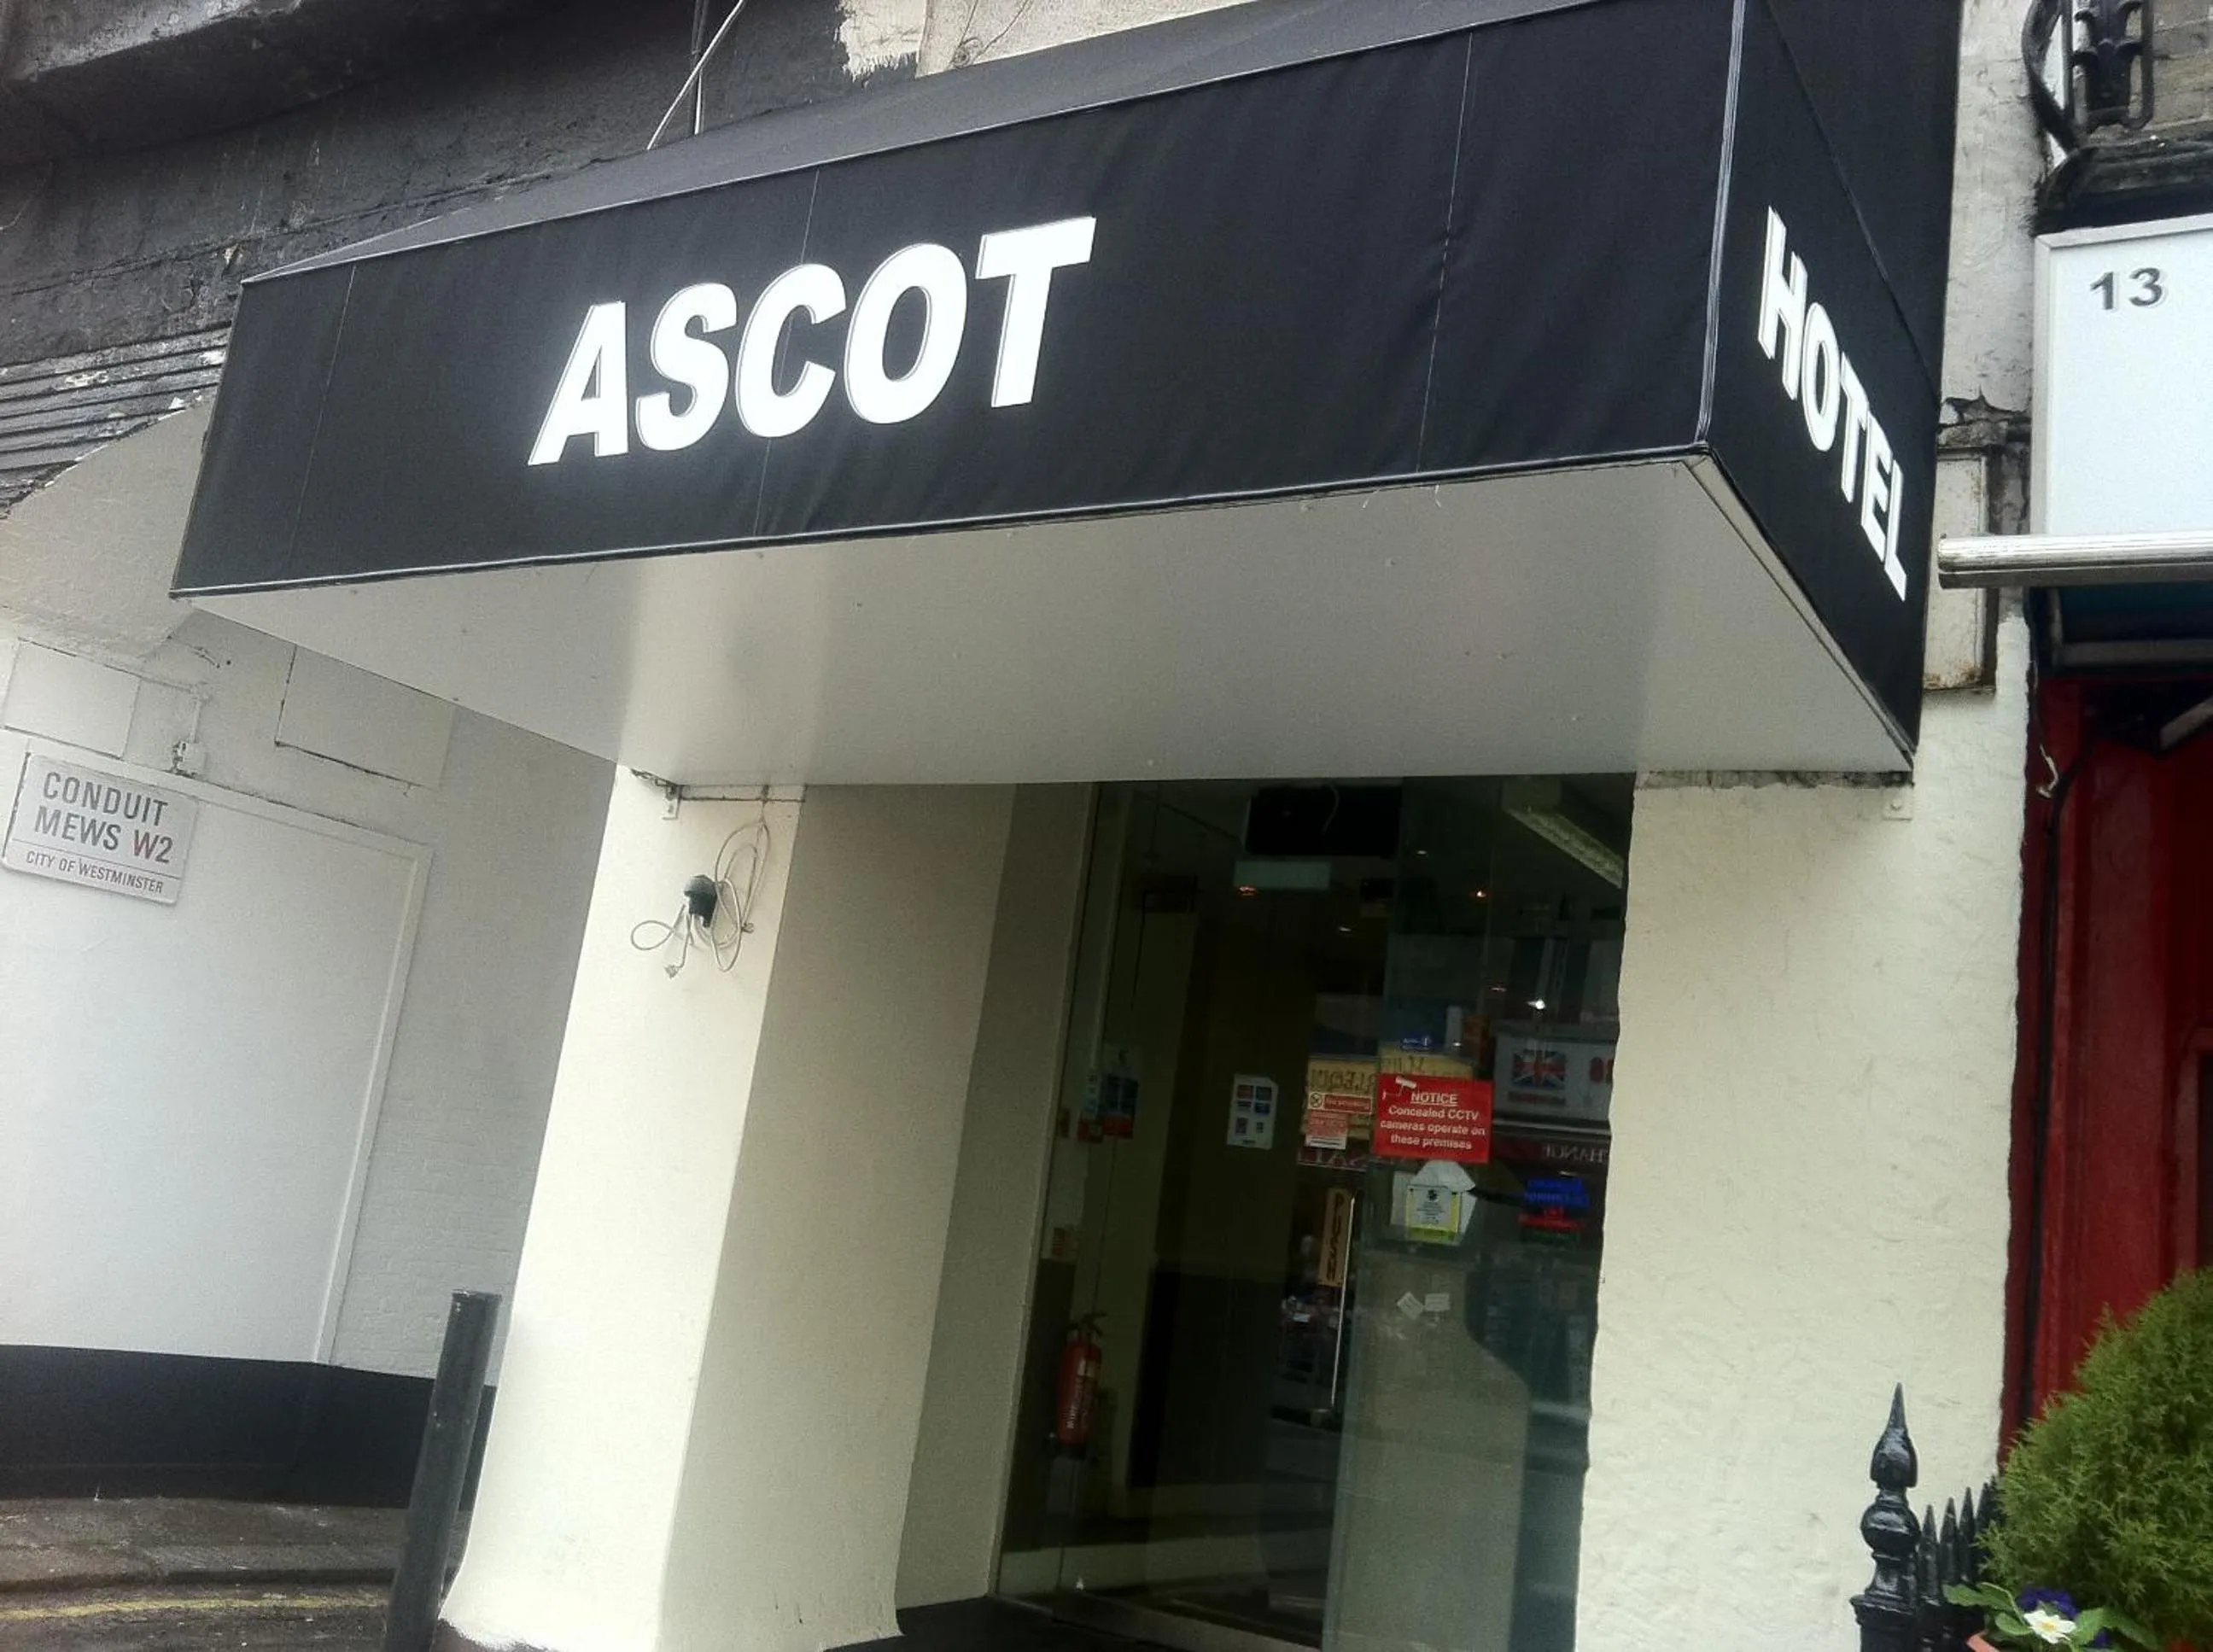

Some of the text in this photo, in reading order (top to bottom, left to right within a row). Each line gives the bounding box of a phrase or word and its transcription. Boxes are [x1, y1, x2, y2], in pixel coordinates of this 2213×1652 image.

[2089, 267, 2166, 311] 13
[528, 216, 1096, 466] ASCOT
[1758, 206, 1906, 601] HOTEL
[44, 772, 168, 826] CONDUIT
[34, 806, 174, 864] MEWS W2
[26, 850, 164, 894] CITY OF WESTMINSTER
[1388, 1105, 1480, 1120] Concealed CCTV
[1411, 1092, 1458, 1105] NOTICE
[1381, 1120, 1425, 1130] cameras
[1428, 1124, 1469, 1135] operate
[1391, 1134, 1472, 1150] these premises
[1326, 1193, 1344, 1281] PUSH
